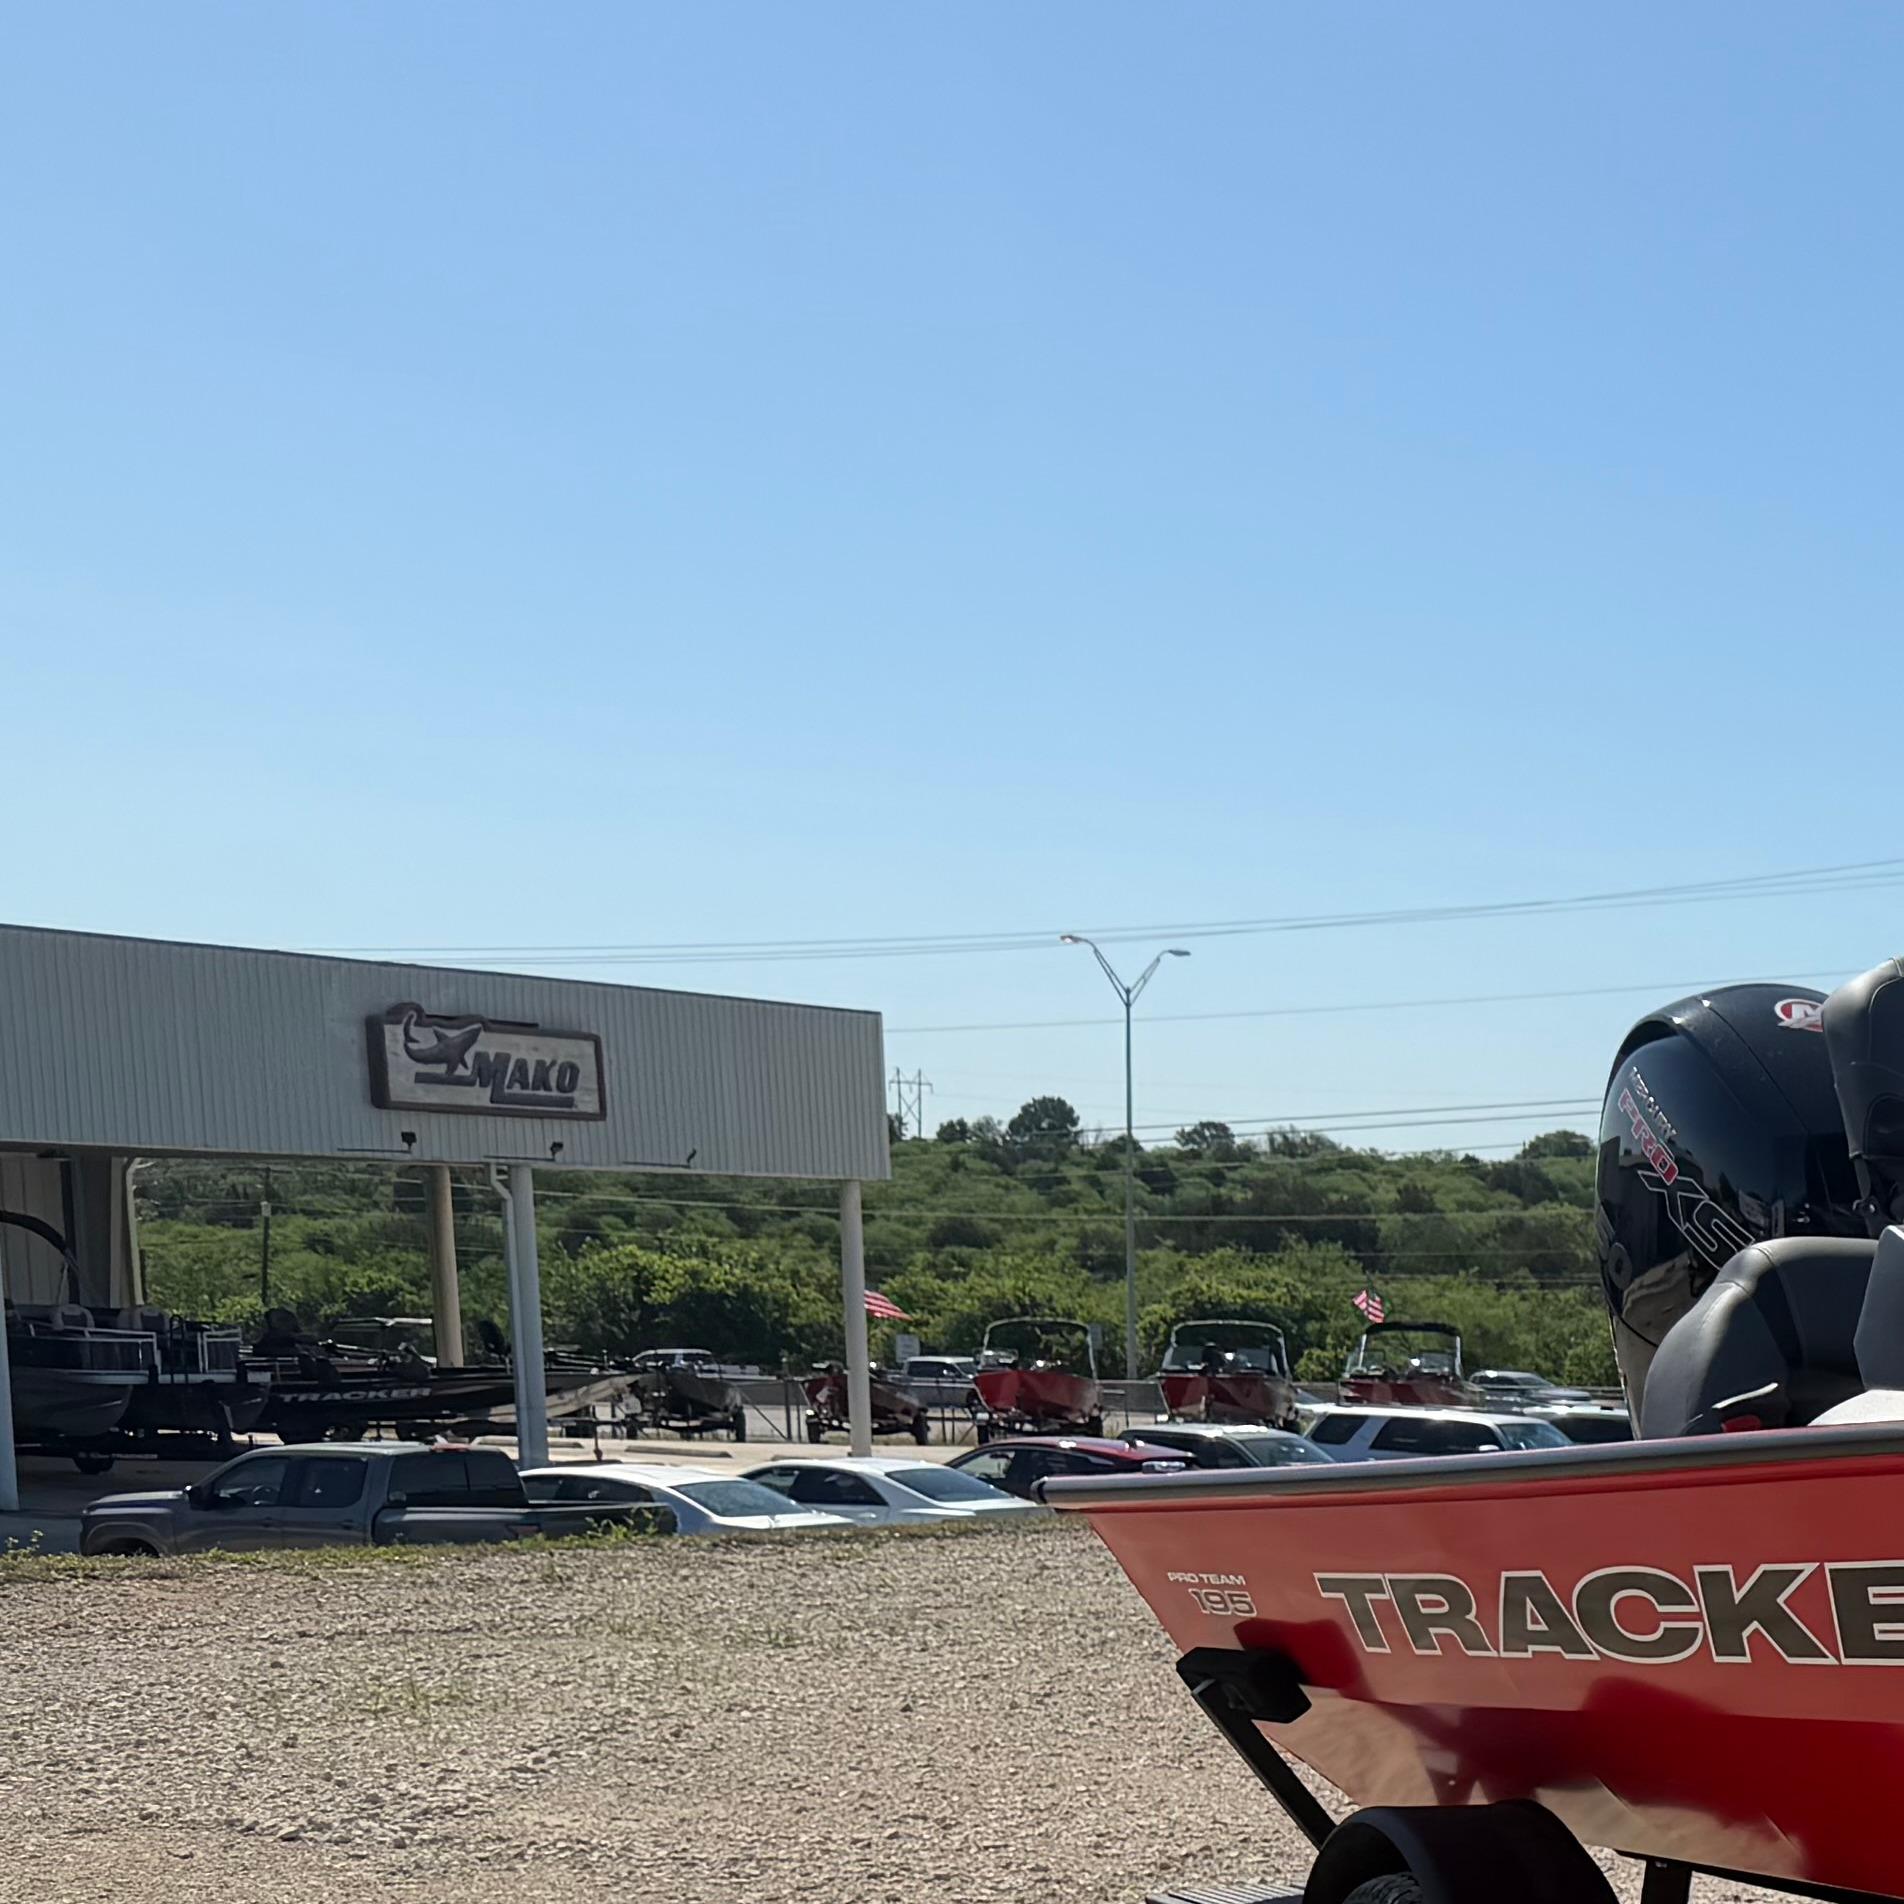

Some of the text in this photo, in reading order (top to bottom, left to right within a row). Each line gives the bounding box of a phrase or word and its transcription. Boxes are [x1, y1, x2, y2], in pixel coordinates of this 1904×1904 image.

[470, 1050, 581, 1104] MAKO
[1617, 1088, 1680, 1186] PRO
[279, 1387, 433, 1403] TRACKER
[1166, 1571, 1247, 1586] PRO TEAM
[1187, 1587, 1258, 1618] 195
